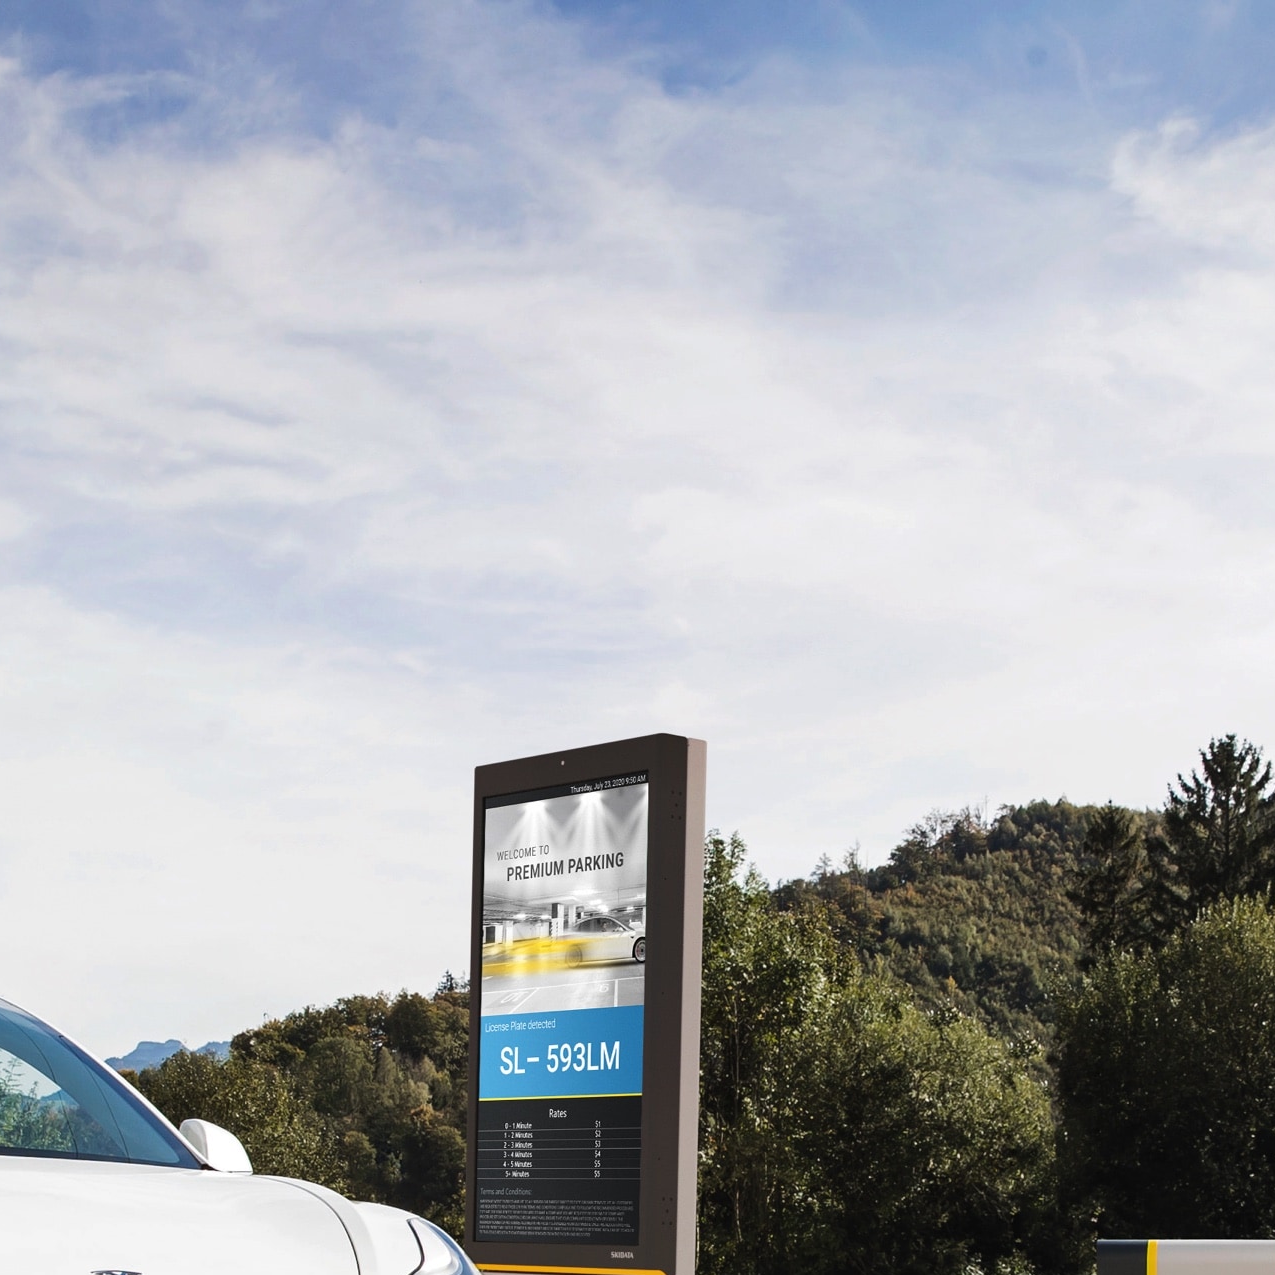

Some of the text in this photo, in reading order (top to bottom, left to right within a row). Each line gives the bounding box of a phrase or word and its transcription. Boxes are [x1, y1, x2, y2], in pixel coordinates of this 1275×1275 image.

[570, 783, 593, 793] Thursday,
[594, 781, 604, 791] July
[637, 774, 646, 782] AM
[497, 845, 550, 861] WELCOME TO
[507, 852, 624, 881] PREMIUM PARKING
[485, 1018, 556, 1032] License Plate detected
[546, 1041, 620, 1073] 593LM
[549, 1108, 567, 1118] Rates
[515, 1131, 533, 1139] Minutes
[515, 1150, 532, 1158] Minutes
[512, 1170, 530, 1178] Minutes
[480, 1187, 494, 1195] Terms
[495, 1187, 504, 1195] and
[610, 1251, 634, 1259] SKIDATA
